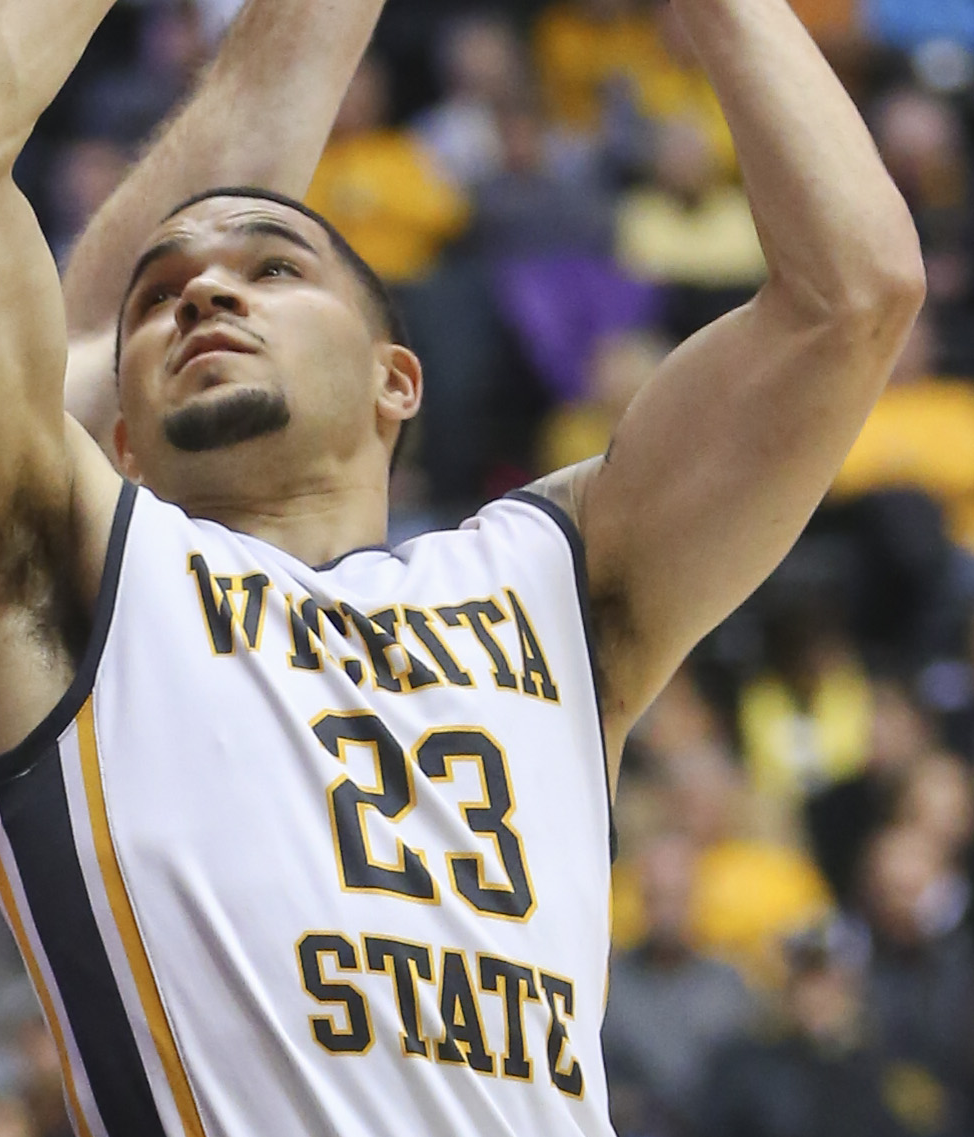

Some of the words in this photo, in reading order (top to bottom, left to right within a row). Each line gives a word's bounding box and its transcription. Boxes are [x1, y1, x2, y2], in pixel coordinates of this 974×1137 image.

[187, 549, 562, 706] WICHITA
[310, 709, 538, 923] 23
[295, 930, 585, 1100] STATE
